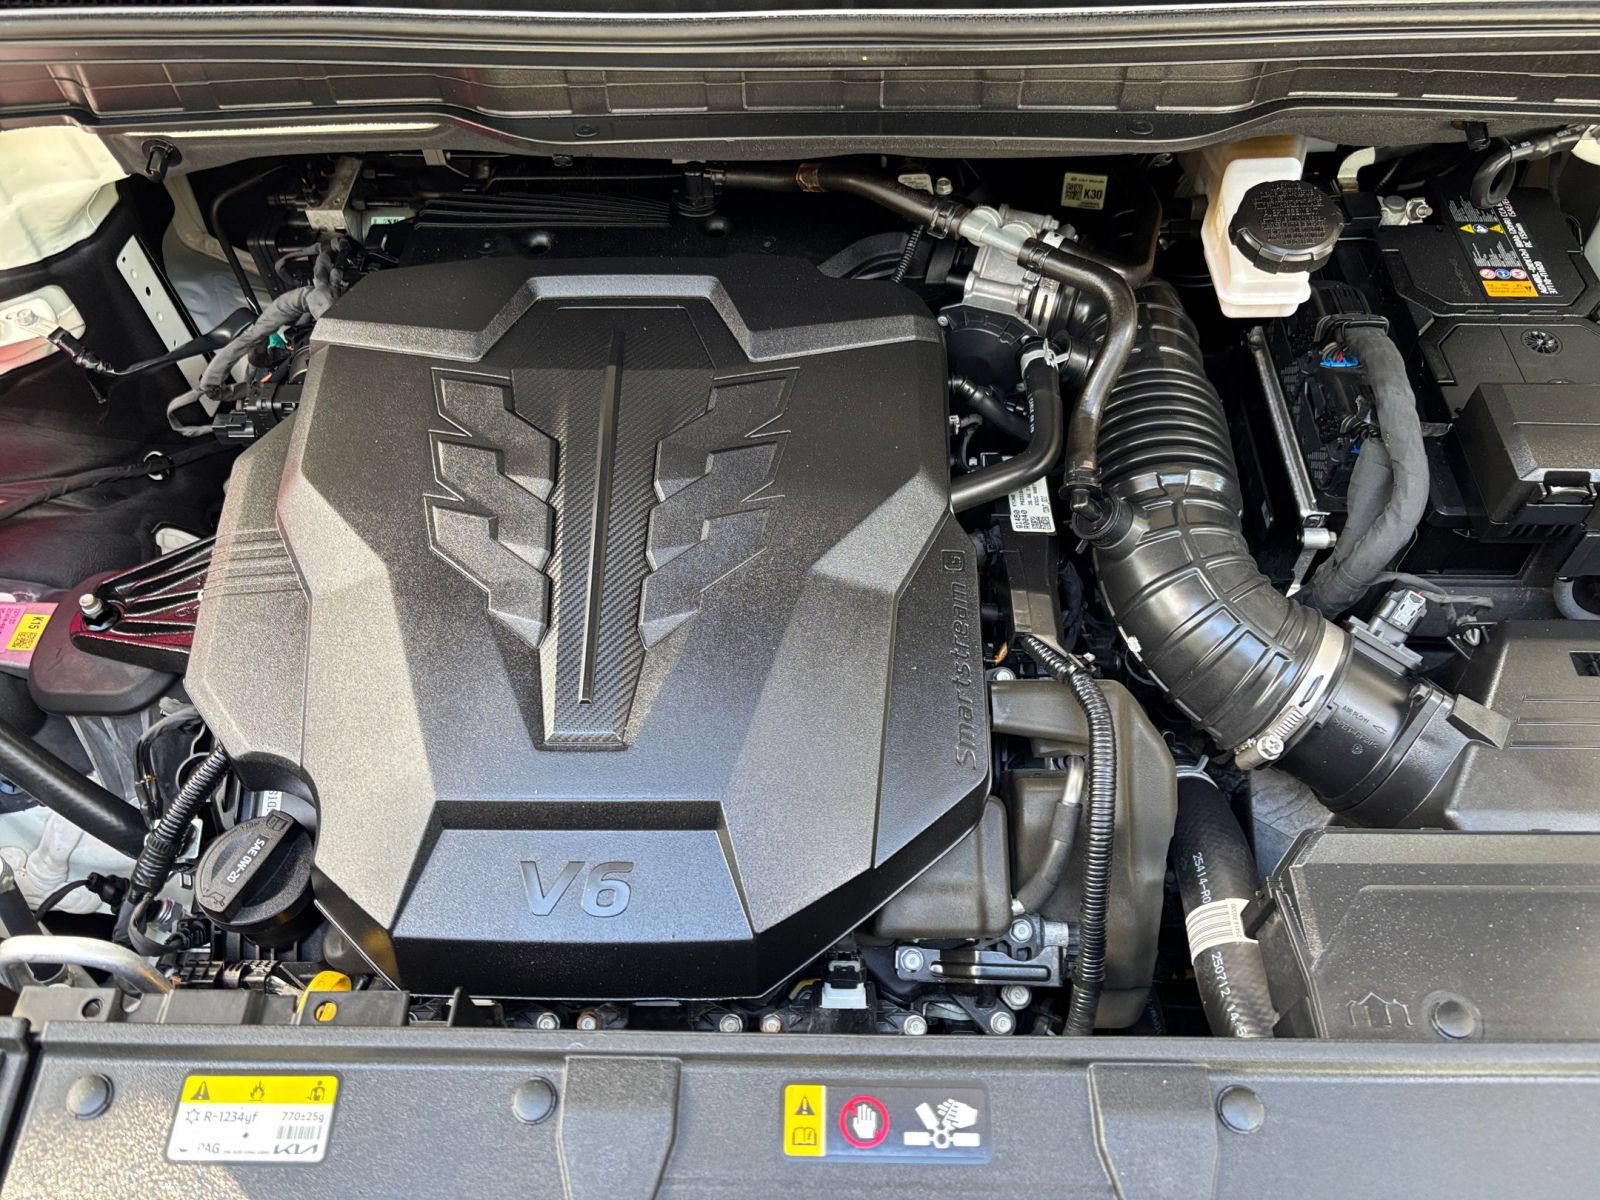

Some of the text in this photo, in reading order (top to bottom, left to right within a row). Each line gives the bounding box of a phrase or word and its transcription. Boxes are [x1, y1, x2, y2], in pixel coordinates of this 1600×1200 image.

[1083, 188, 1103, 200] K30
[28, 616, 45, 630] K15
[950, 581, 977, 771] Smartstream
[247, 838, 265, 857] SAE
[226, 855, 252, 883] 0W-20
[519, 860, 634, 918] V6
[1211, 951, 1231, 998] 250712
[203, 1110, 258, 1125] R-1234yf
